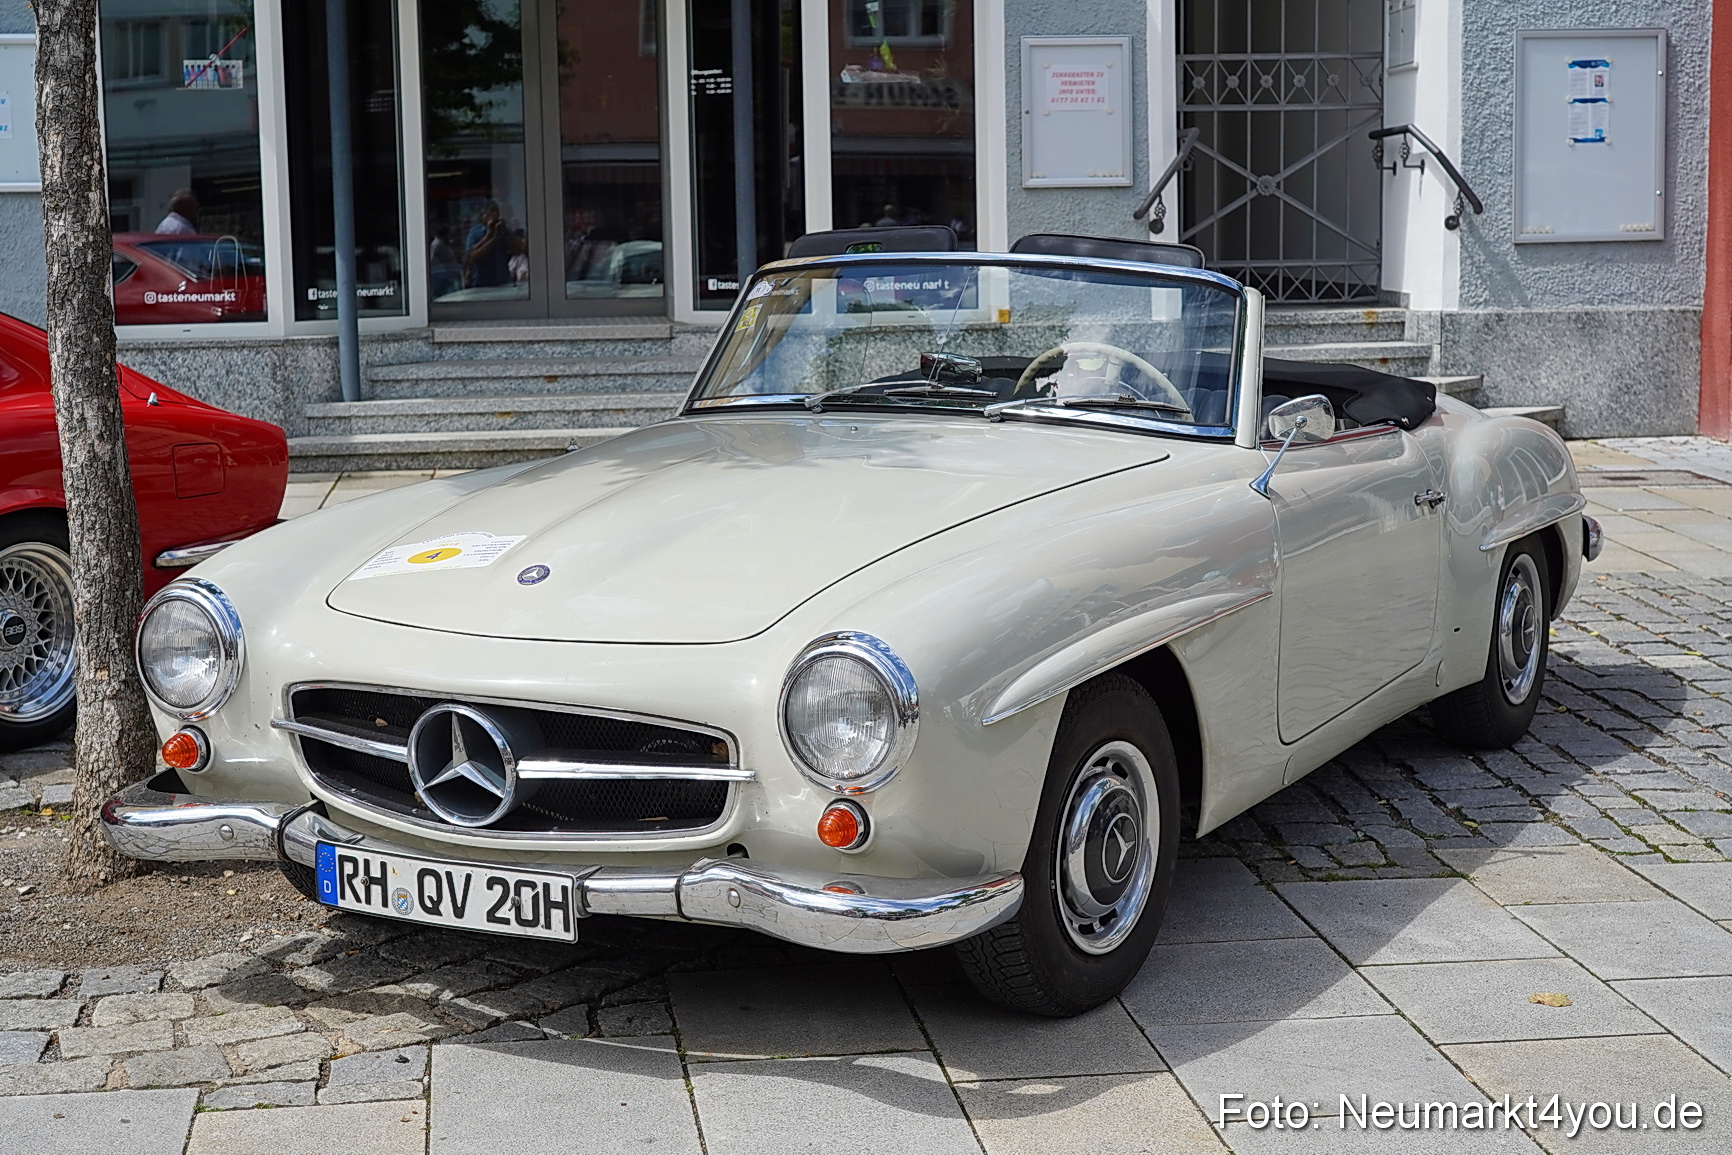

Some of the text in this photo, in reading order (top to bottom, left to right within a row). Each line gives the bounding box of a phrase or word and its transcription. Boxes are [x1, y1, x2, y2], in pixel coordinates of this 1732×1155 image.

[157, 290, 236, 303] tasteneumarkt
[425, 551, 443, 560] 4
[5, 624, 25, 637] BBS
[323, 880, 332, 894] D
[337, 853, 572, 933] RH QV 20H
